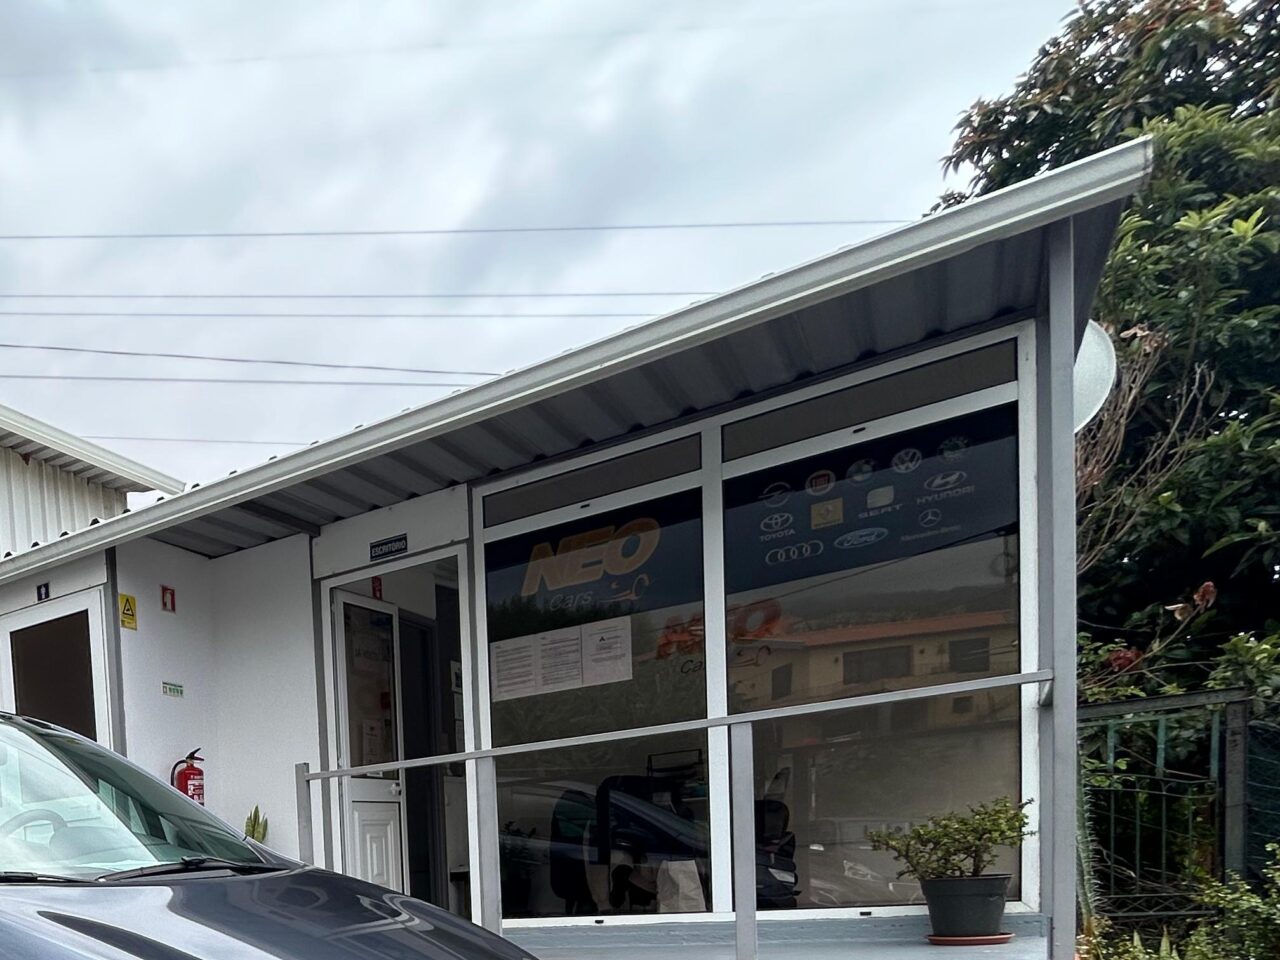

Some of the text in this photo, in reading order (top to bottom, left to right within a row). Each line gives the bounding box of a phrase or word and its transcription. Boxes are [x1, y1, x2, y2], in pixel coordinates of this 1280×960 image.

[916, 485, 975, 505] HYUNDAI
[858, 503, 903, 520] SEAT
[759, 528, 796, 543] TOYOTA
[521, 517, 662, 597] NEO
[548, 590, 593, 612] Cars
